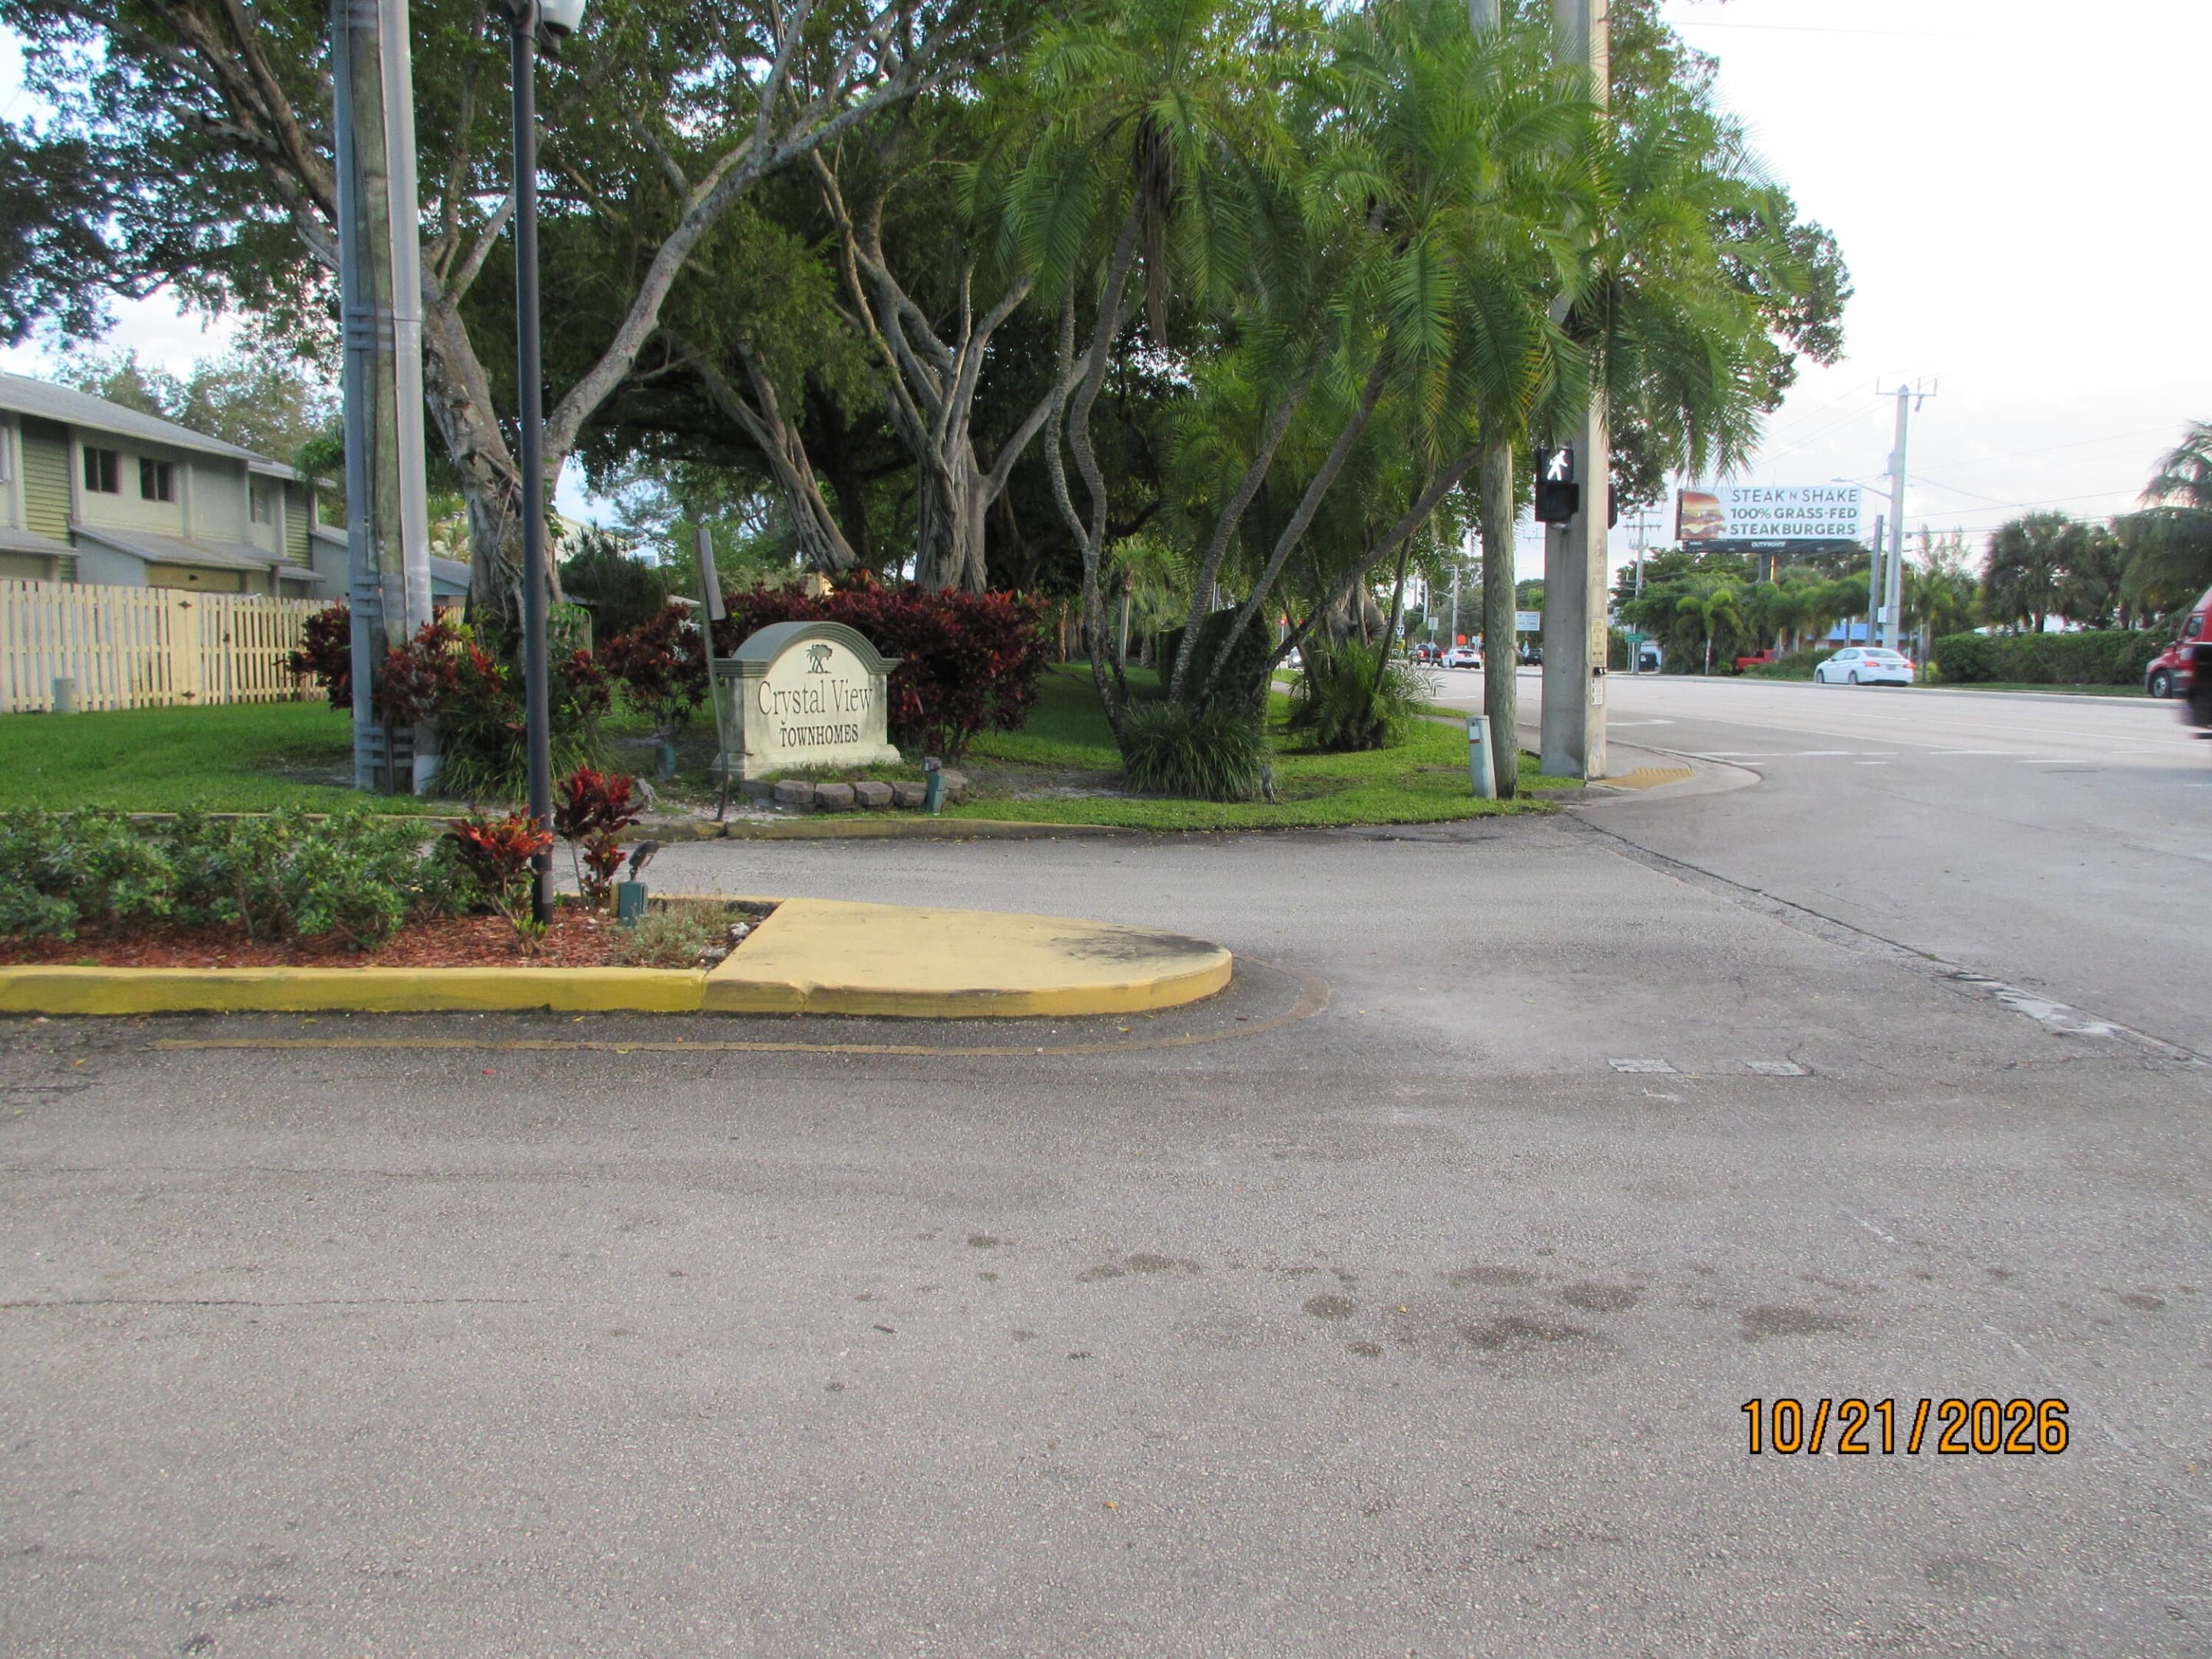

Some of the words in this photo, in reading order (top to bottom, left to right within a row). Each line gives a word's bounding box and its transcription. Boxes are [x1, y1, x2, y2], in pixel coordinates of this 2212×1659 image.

[1731, 488, 1785, 502] STEAK
[1789, 492, 1797, 500] N
[1802, 488, 1857, 502] SHAKE
[1730, 508, 1771, 519] 100%
[1774, 507, 1857, 519] GRASS-FED
[1730, 523, 1856, 535] STEAKBURGERS
[758, 680, 826, 725] Crystal
[832, 679, 873, 713] View
[780, 724, 859, 747] TOWNHOMES
